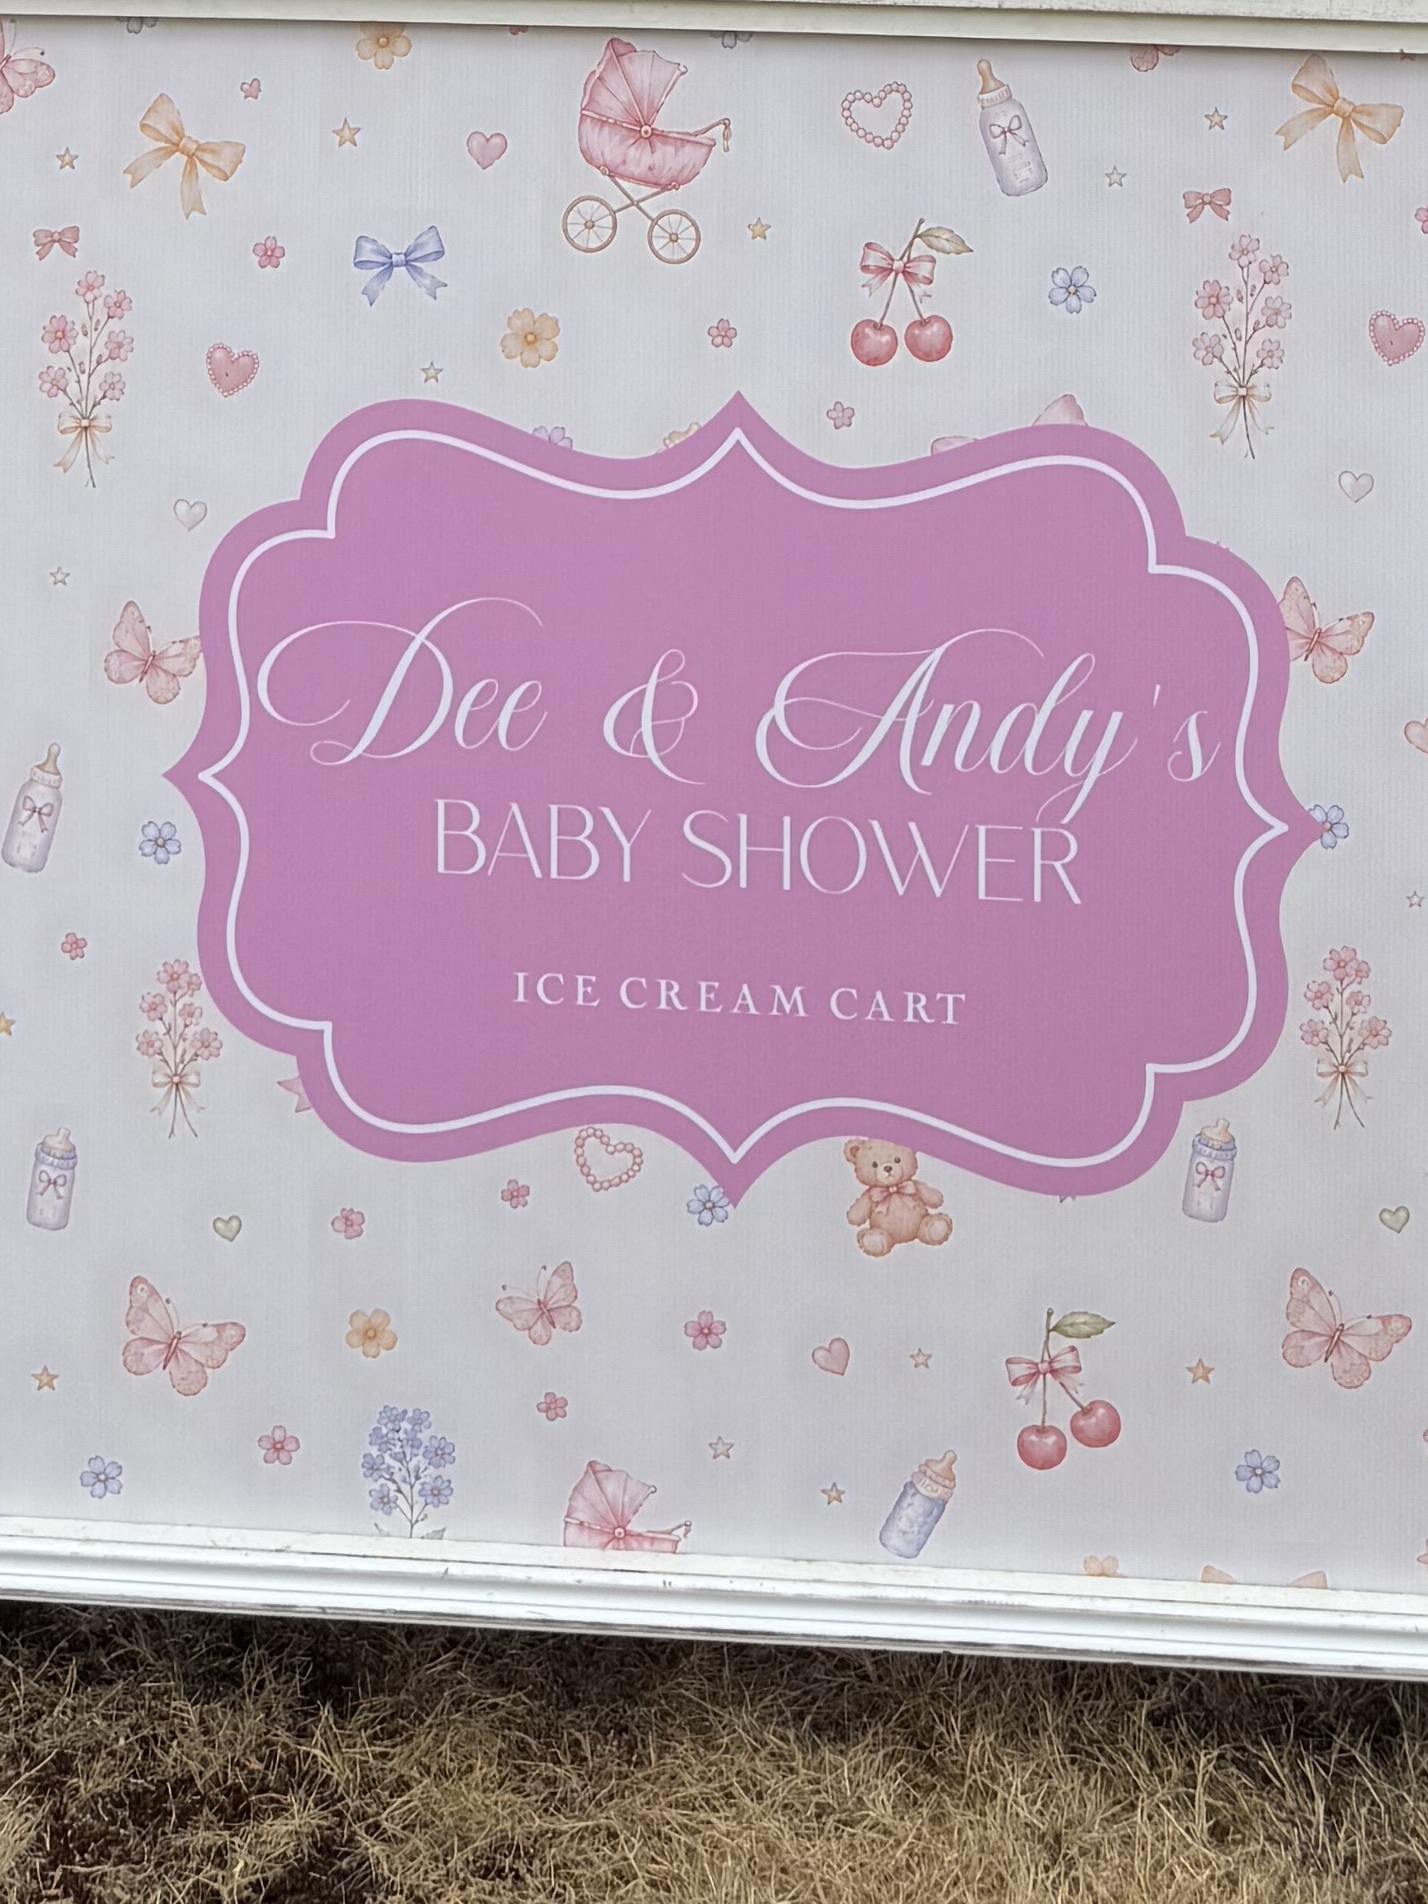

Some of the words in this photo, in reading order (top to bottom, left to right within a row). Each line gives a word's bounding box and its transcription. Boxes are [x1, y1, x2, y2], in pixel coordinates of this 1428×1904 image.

[256, 597, 549, 767] Dee
[603, 648, 707, 785] &
[755, 628, 1222, 824] Andy's
[434, 797, 651, 884] BABY
[681, 807, 1083, 906] SHOWER
[513, 971, 601, 1009] ICE
[619, 976, 809, 1020] CREAM
[829, 987, 967, 1027] CART
